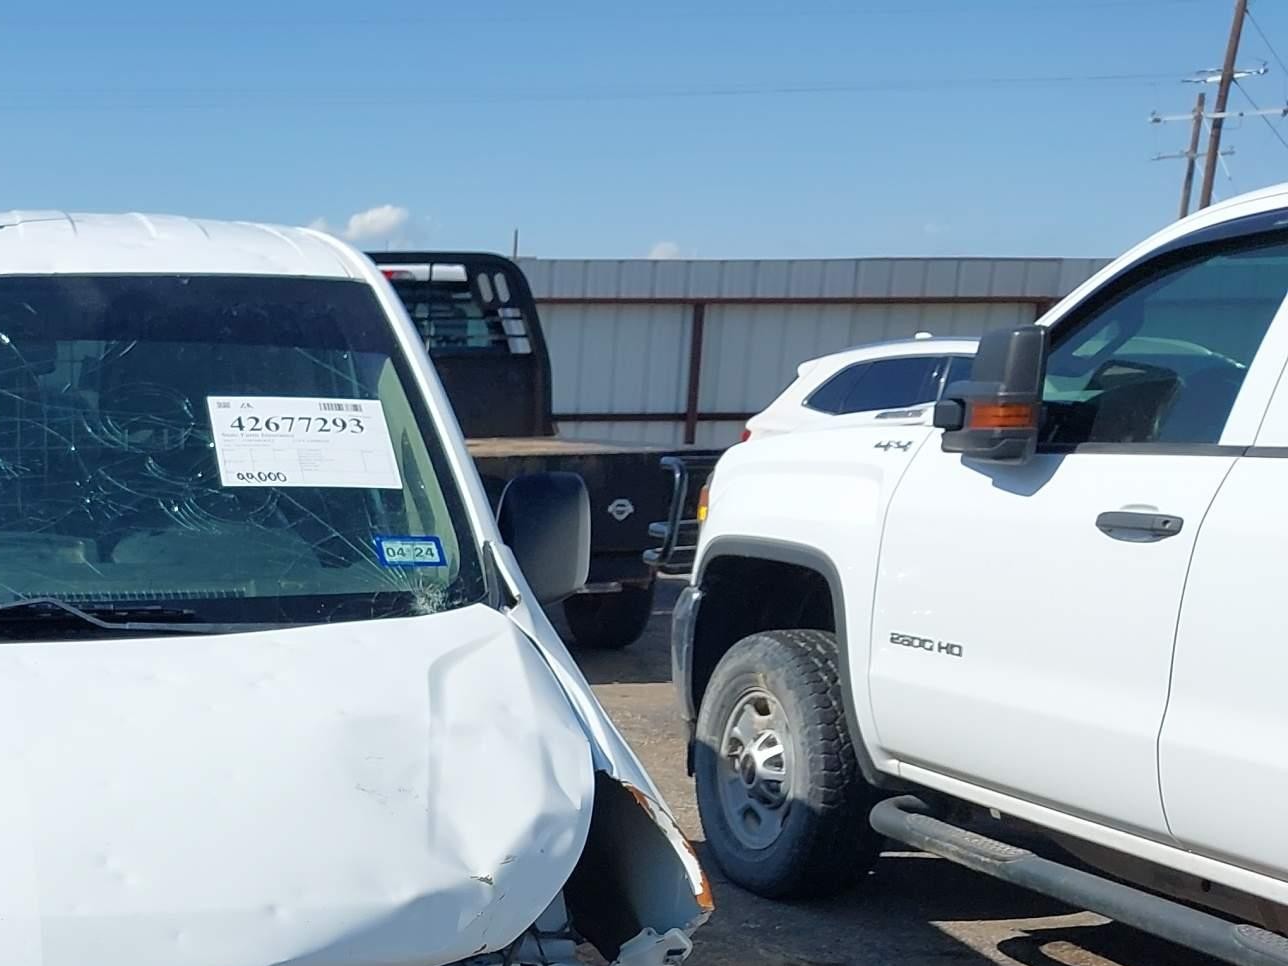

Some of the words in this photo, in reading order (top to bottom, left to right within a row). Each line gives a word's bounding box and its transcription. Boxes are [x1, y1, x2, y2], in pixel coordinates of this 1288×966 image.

[230, 416, 365, 434] 42677293
[386, 547, 407, 558] 04
[414, 547, 435, 558] 24
[937, 641, 963, 658] HD
